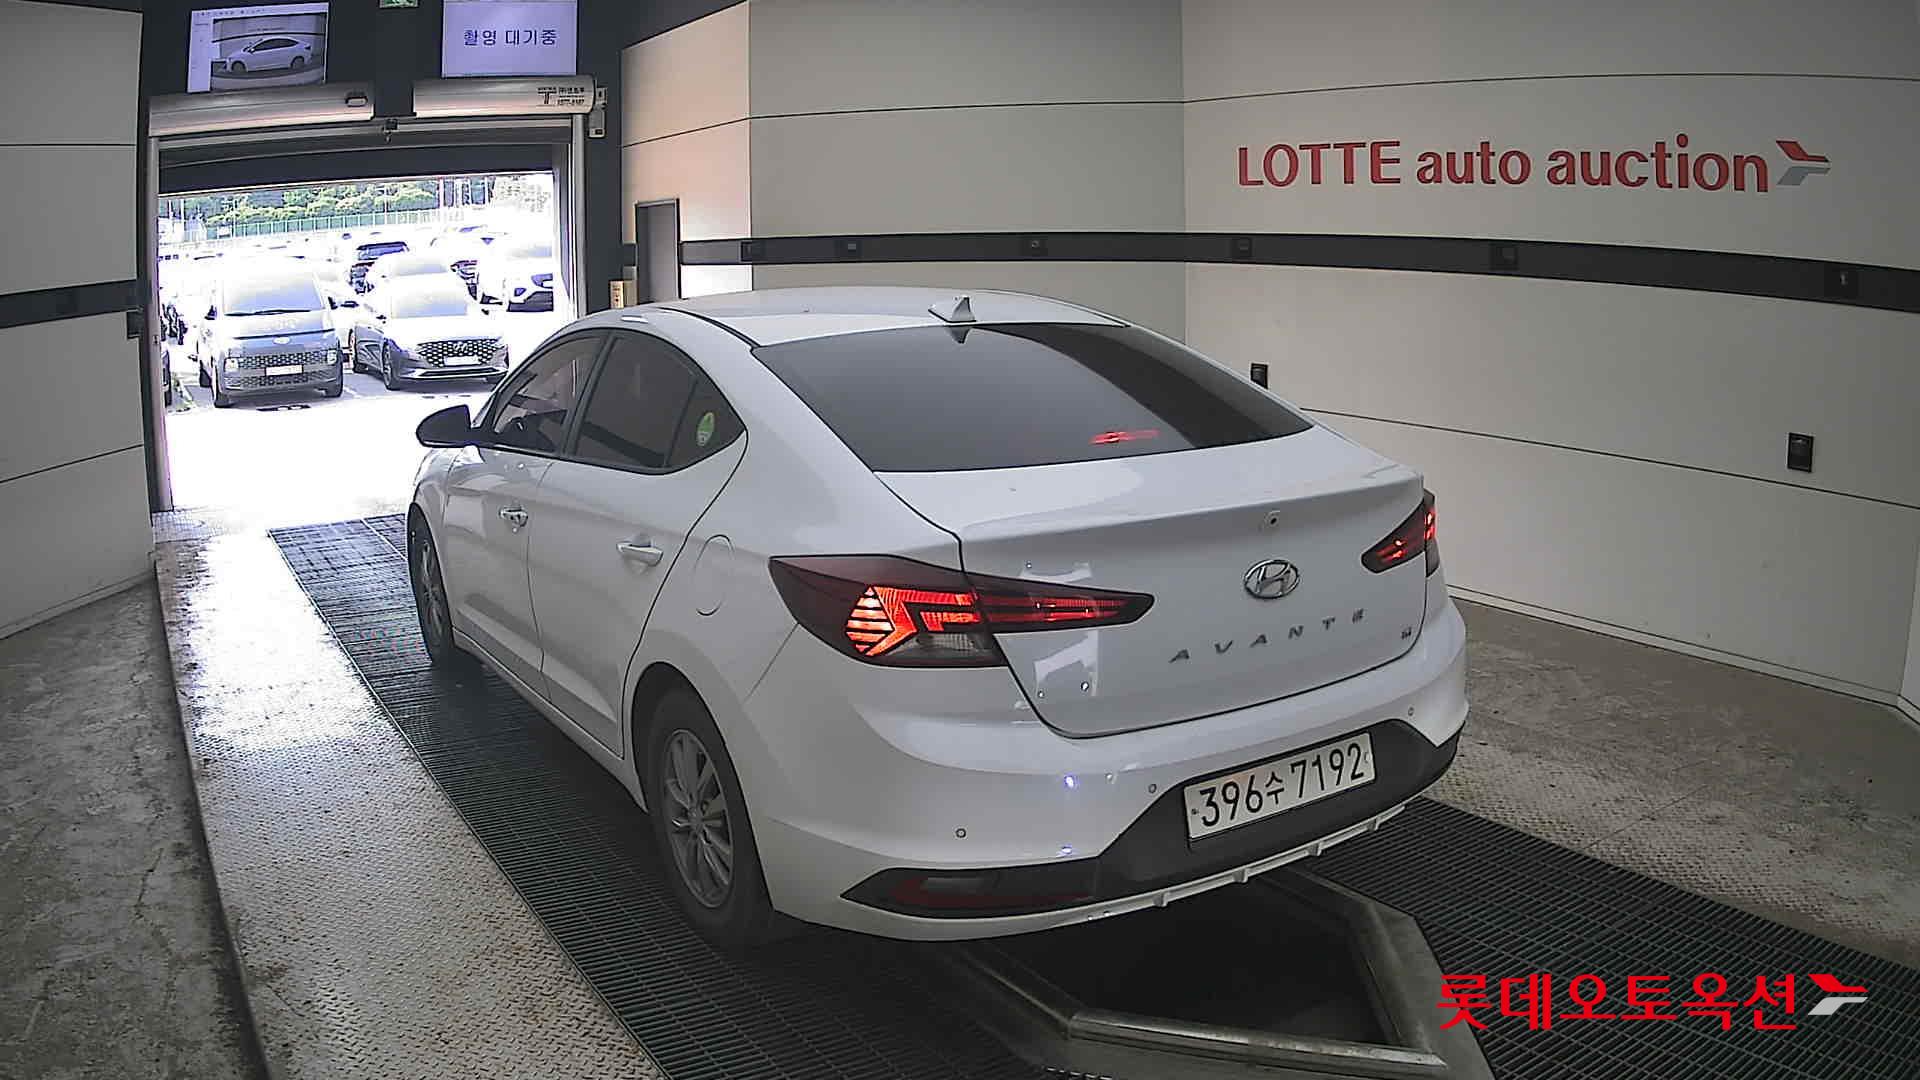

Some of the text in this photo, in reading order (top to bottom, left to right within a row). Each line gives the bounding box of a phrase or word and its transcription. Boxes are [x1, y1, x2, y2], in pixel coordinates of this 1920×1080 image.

[505, 29, 557, 46] 대기중
[1238, 134, 1769, 193] LOTTE auto auction
[1168, 608, 1365, 664] AVANTE
